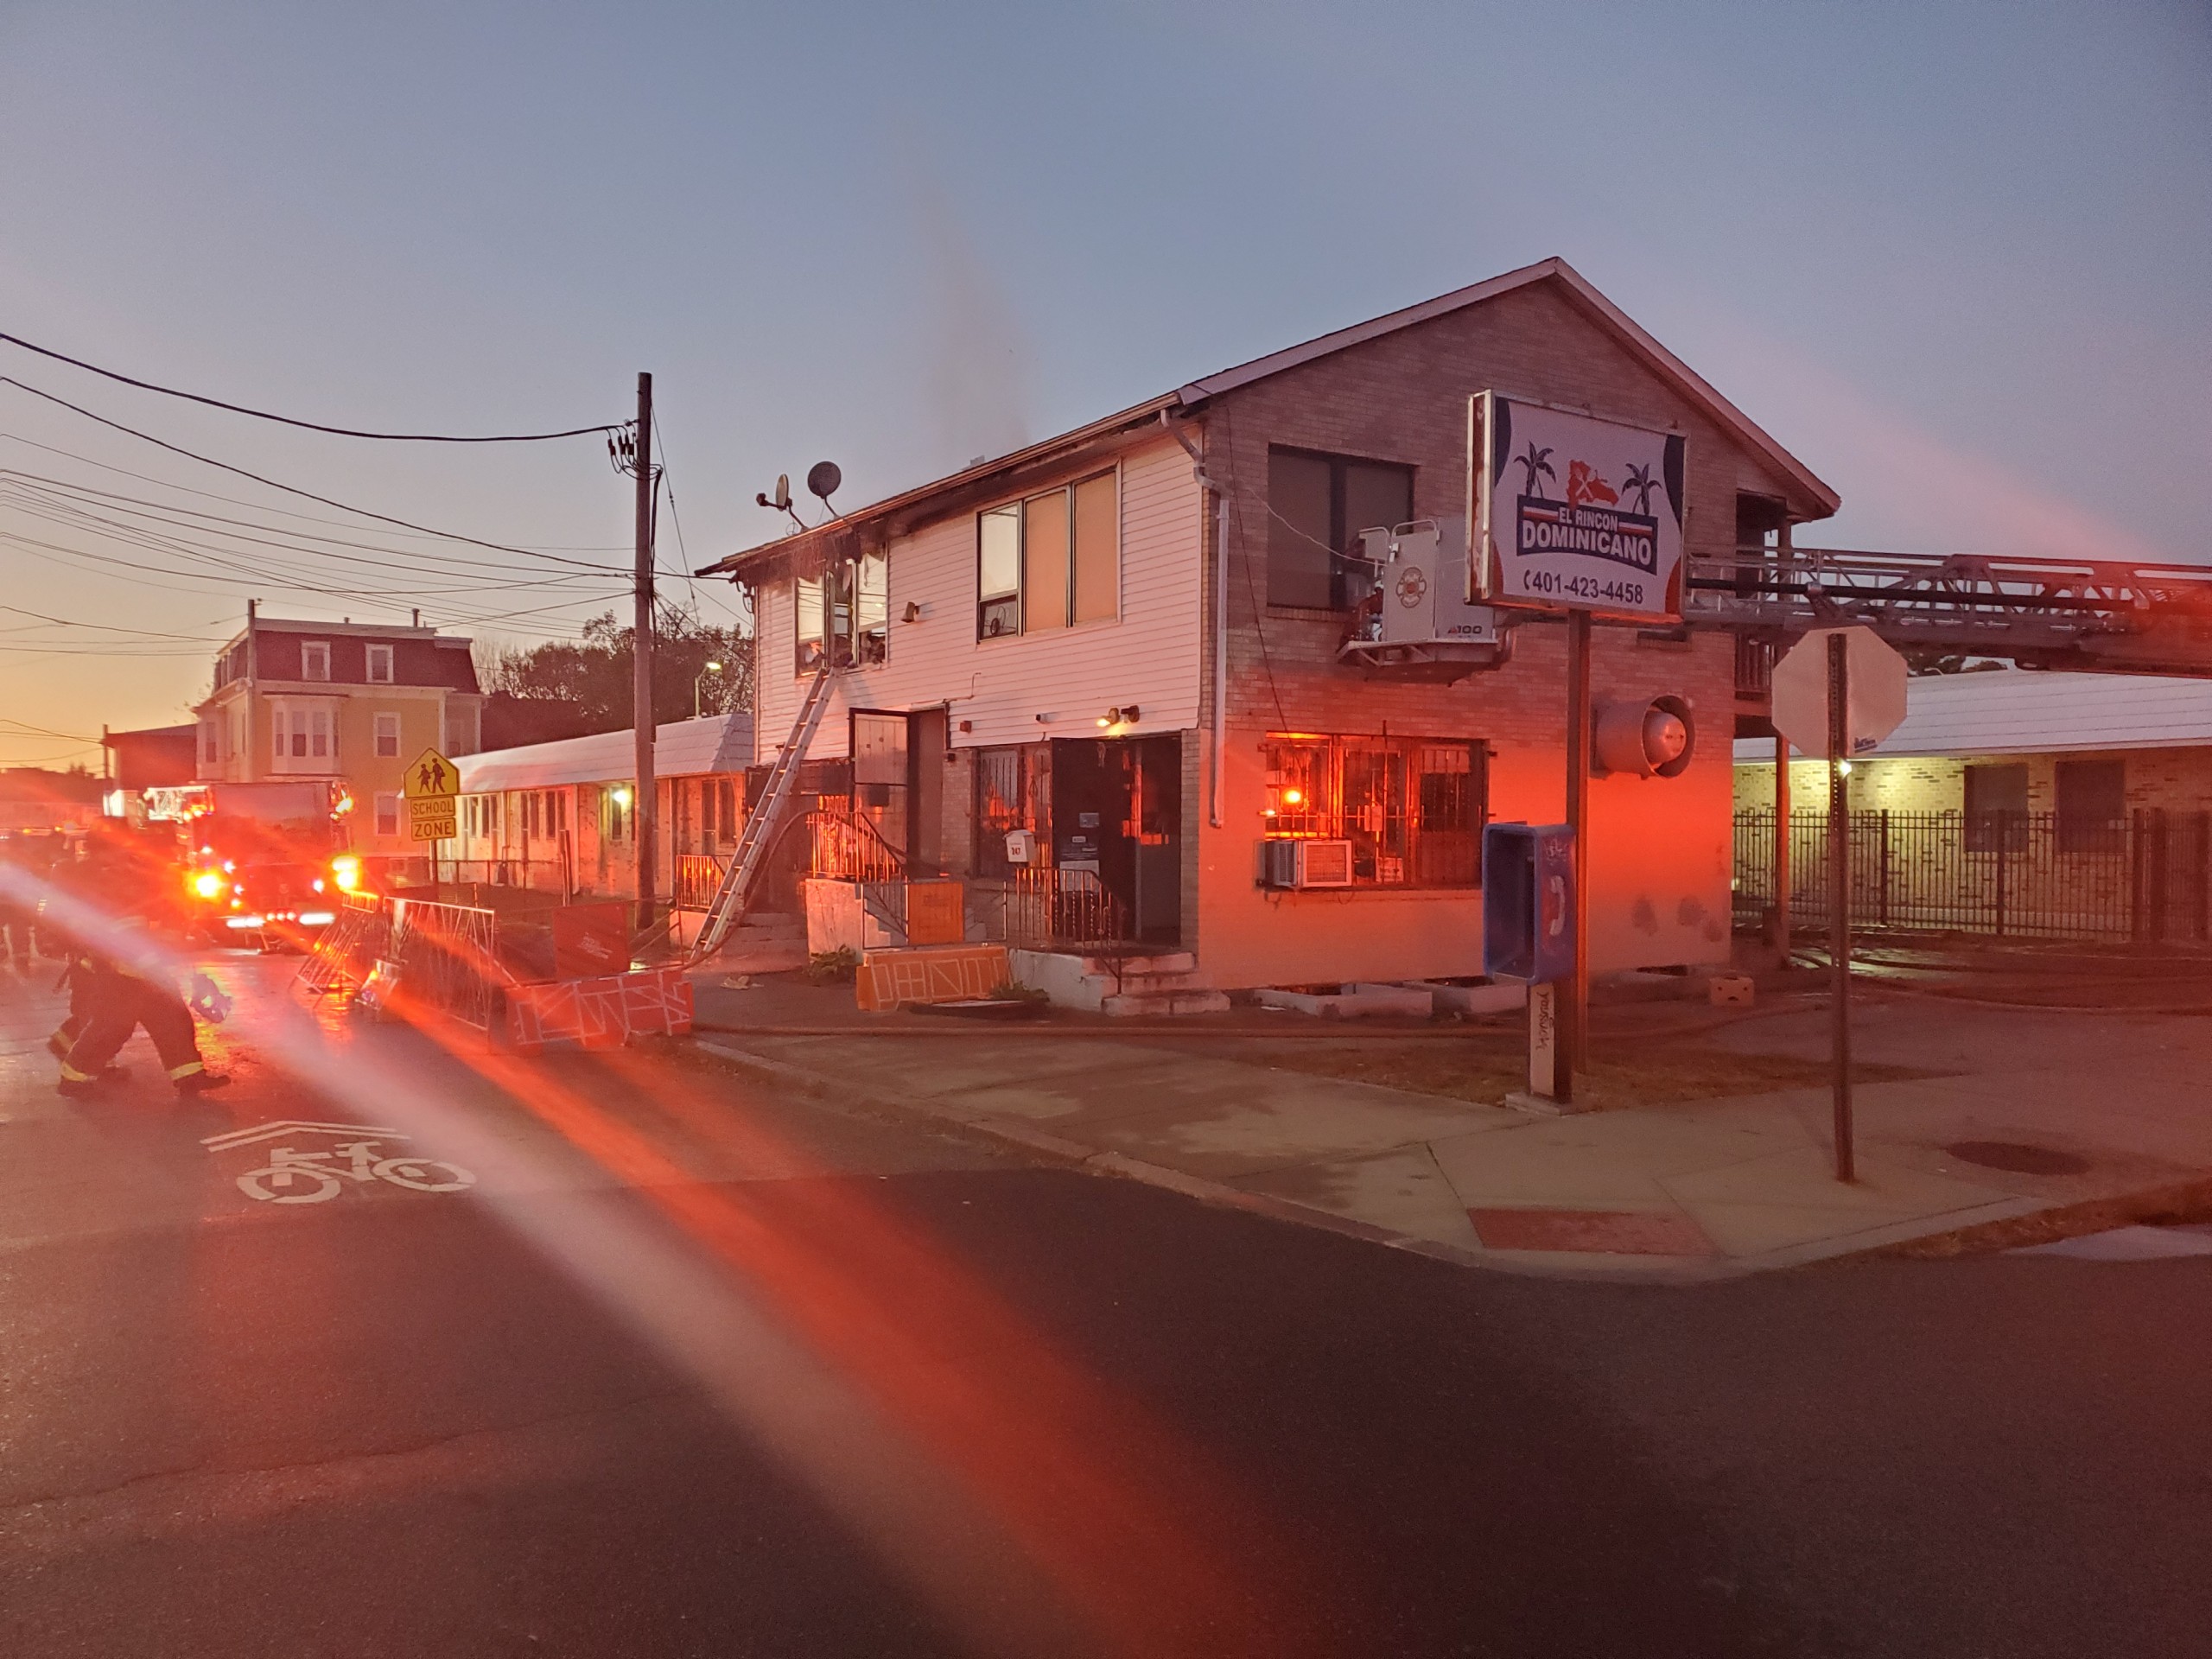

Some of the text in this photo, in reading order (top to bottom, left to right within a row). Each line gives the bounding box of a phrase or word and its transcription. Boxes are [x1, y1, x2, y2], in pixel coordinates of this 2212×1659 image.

[1558, 506, 1619, 531] EL RINCON
[1522, 520, 1652, 567] DOMINICANO
[412, 801, 453, 816] SCHOOL
[415, 821, 453, 837] ZONE
